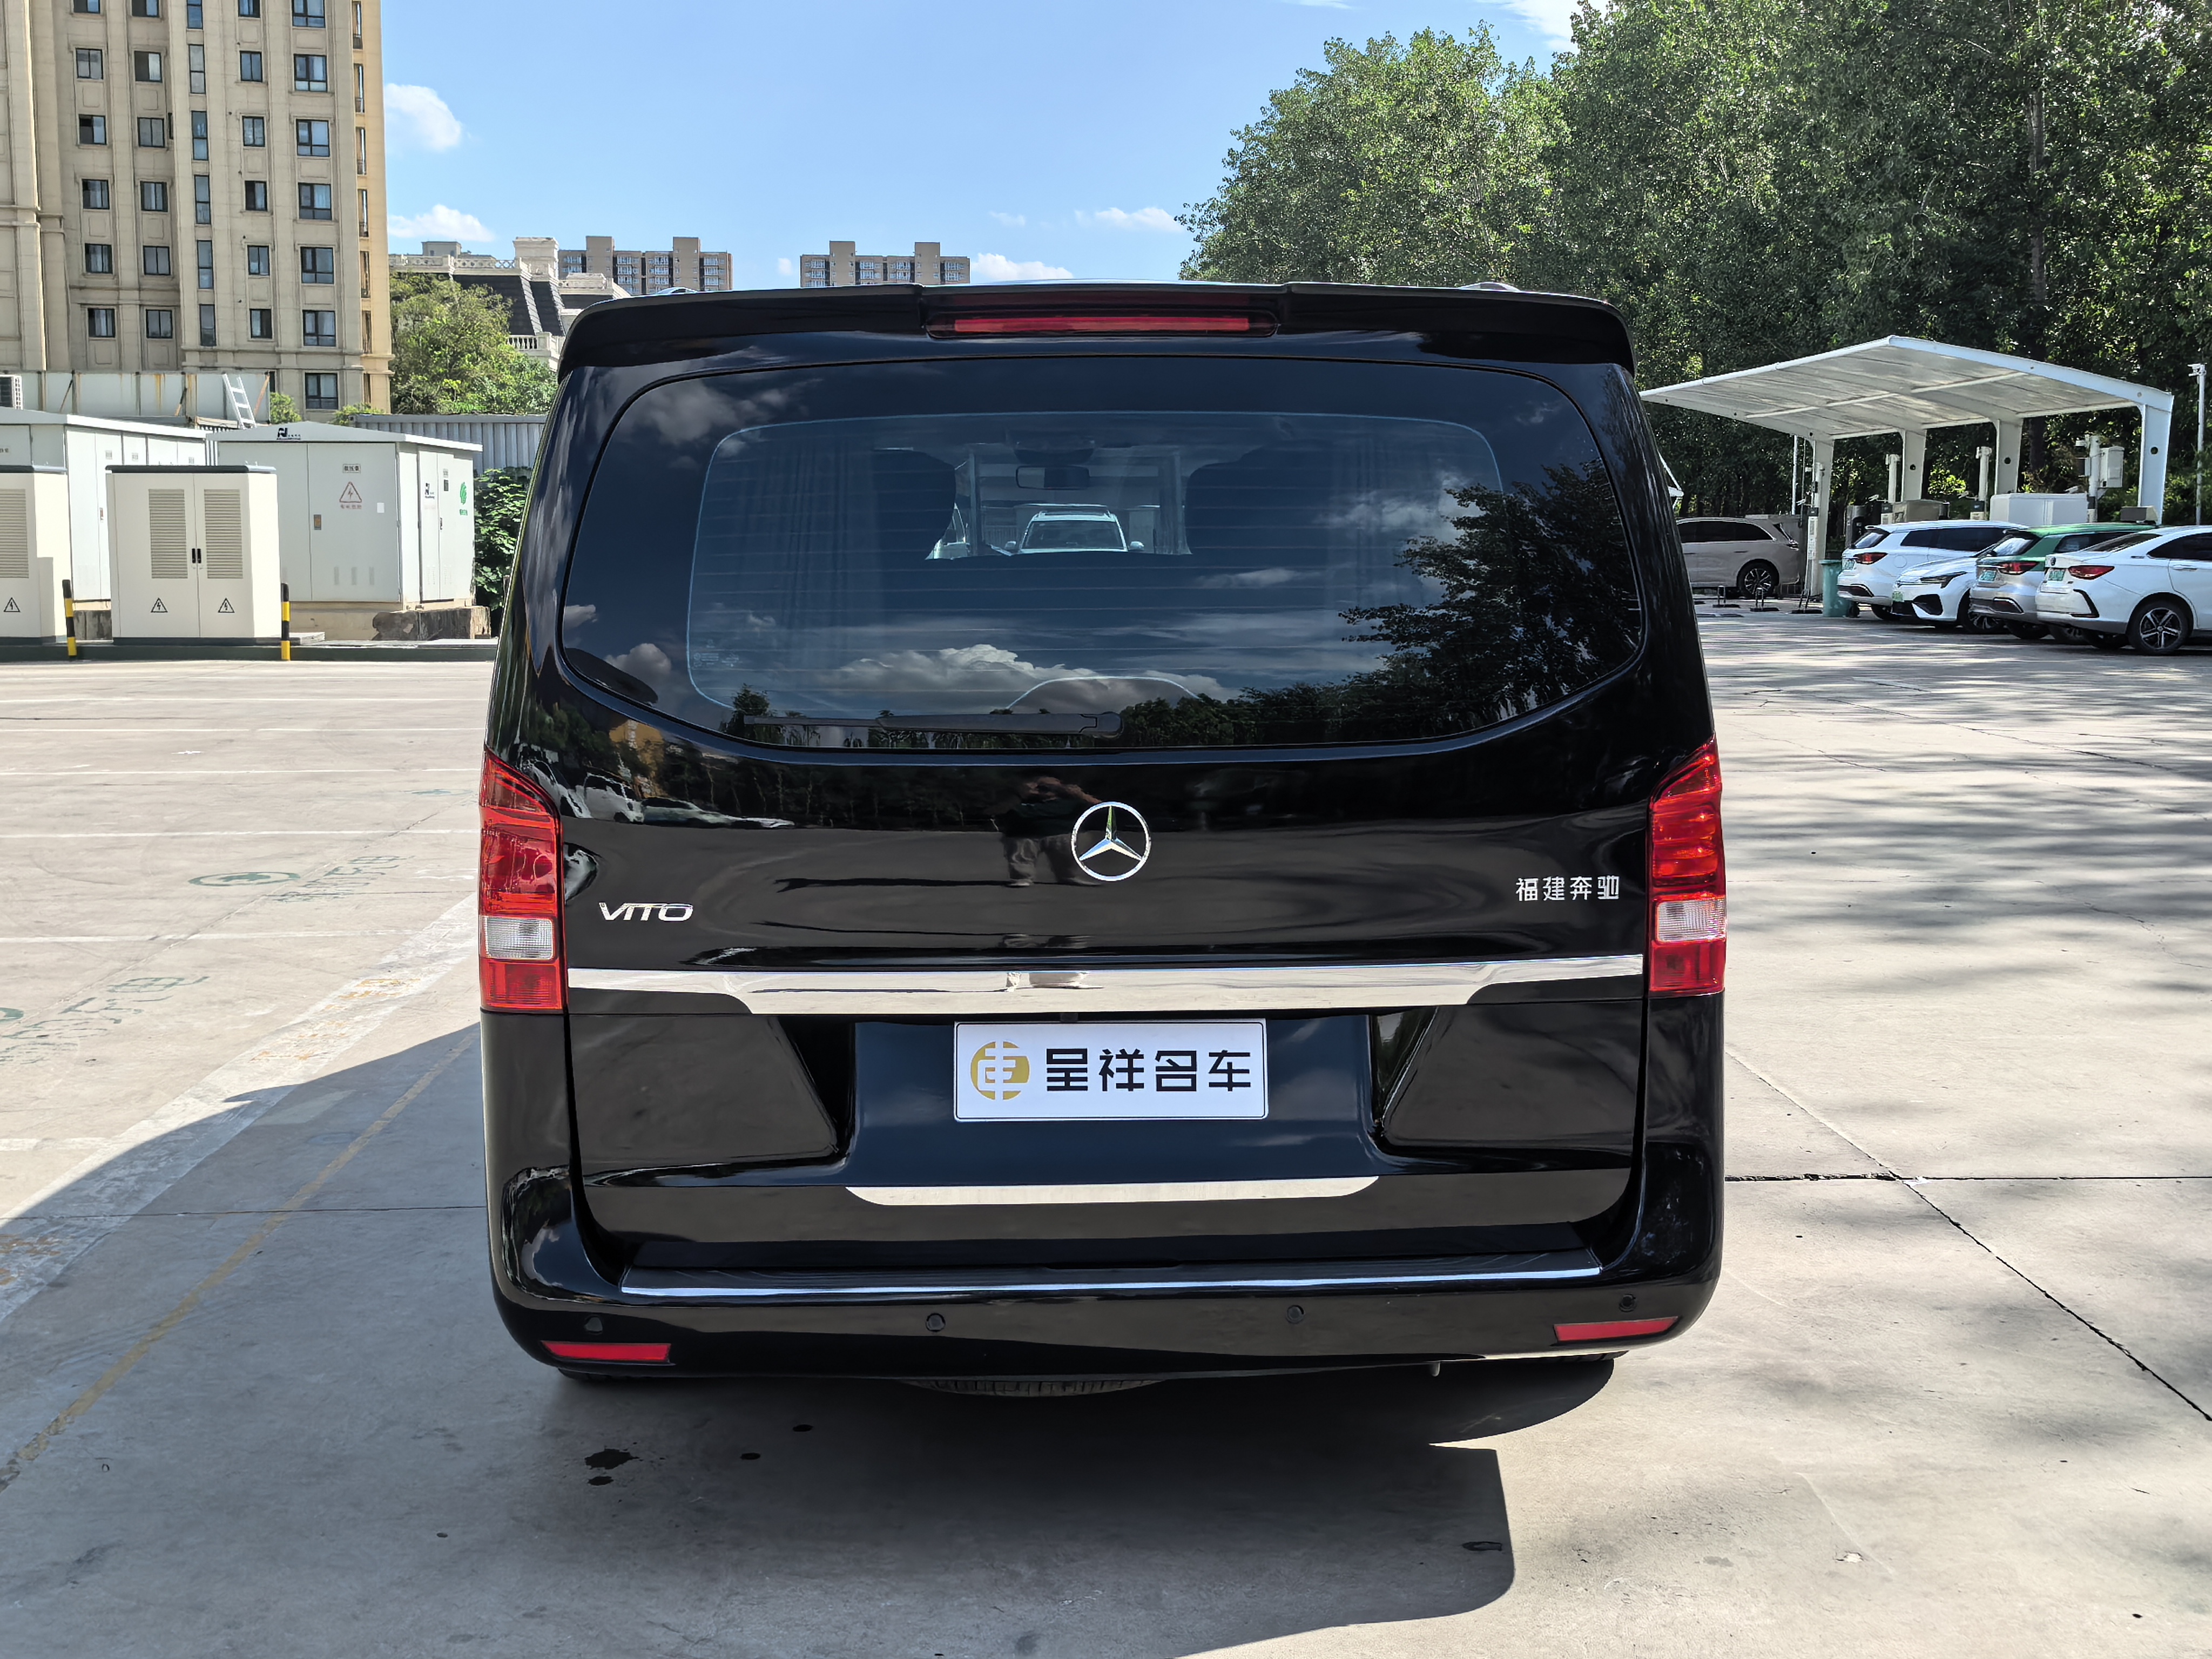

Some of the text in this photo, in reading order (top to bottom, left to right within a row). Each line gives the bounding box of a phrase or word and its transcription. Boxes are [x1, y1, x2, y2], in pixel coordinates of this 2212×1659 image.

[1515, 875, 1620, 901] 福建奔驰
[598, 902, 694, 921] VITO
[1046, 1048, 1251, 1092] 呈祥名车
